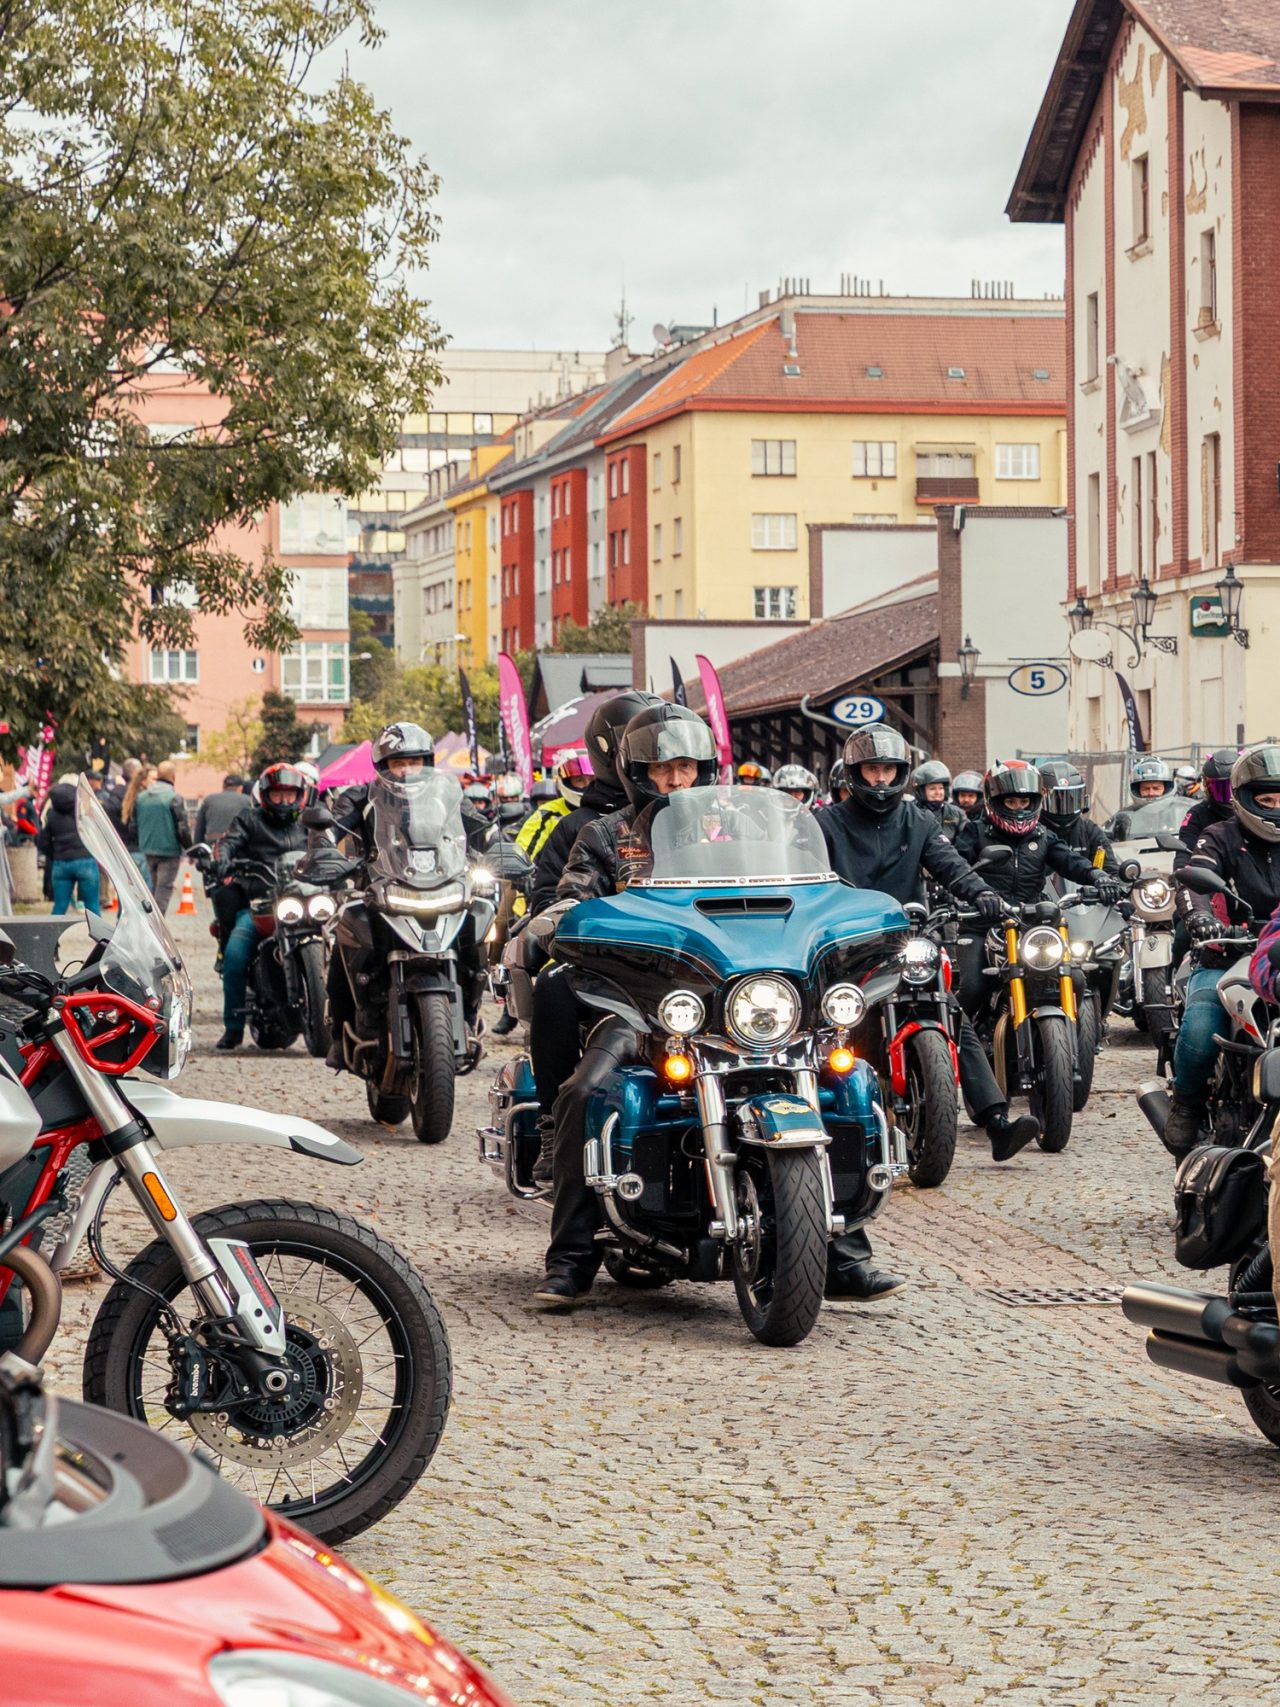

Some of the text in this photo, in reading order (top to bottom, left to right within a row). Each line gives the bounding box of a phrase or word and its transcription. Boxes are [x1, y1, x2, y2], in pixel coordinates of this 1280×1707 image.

[1030, 671, 1046, 689] 5
[845, 702, 873, 719] 29
[190, 1363, 200, 1396] brembo
